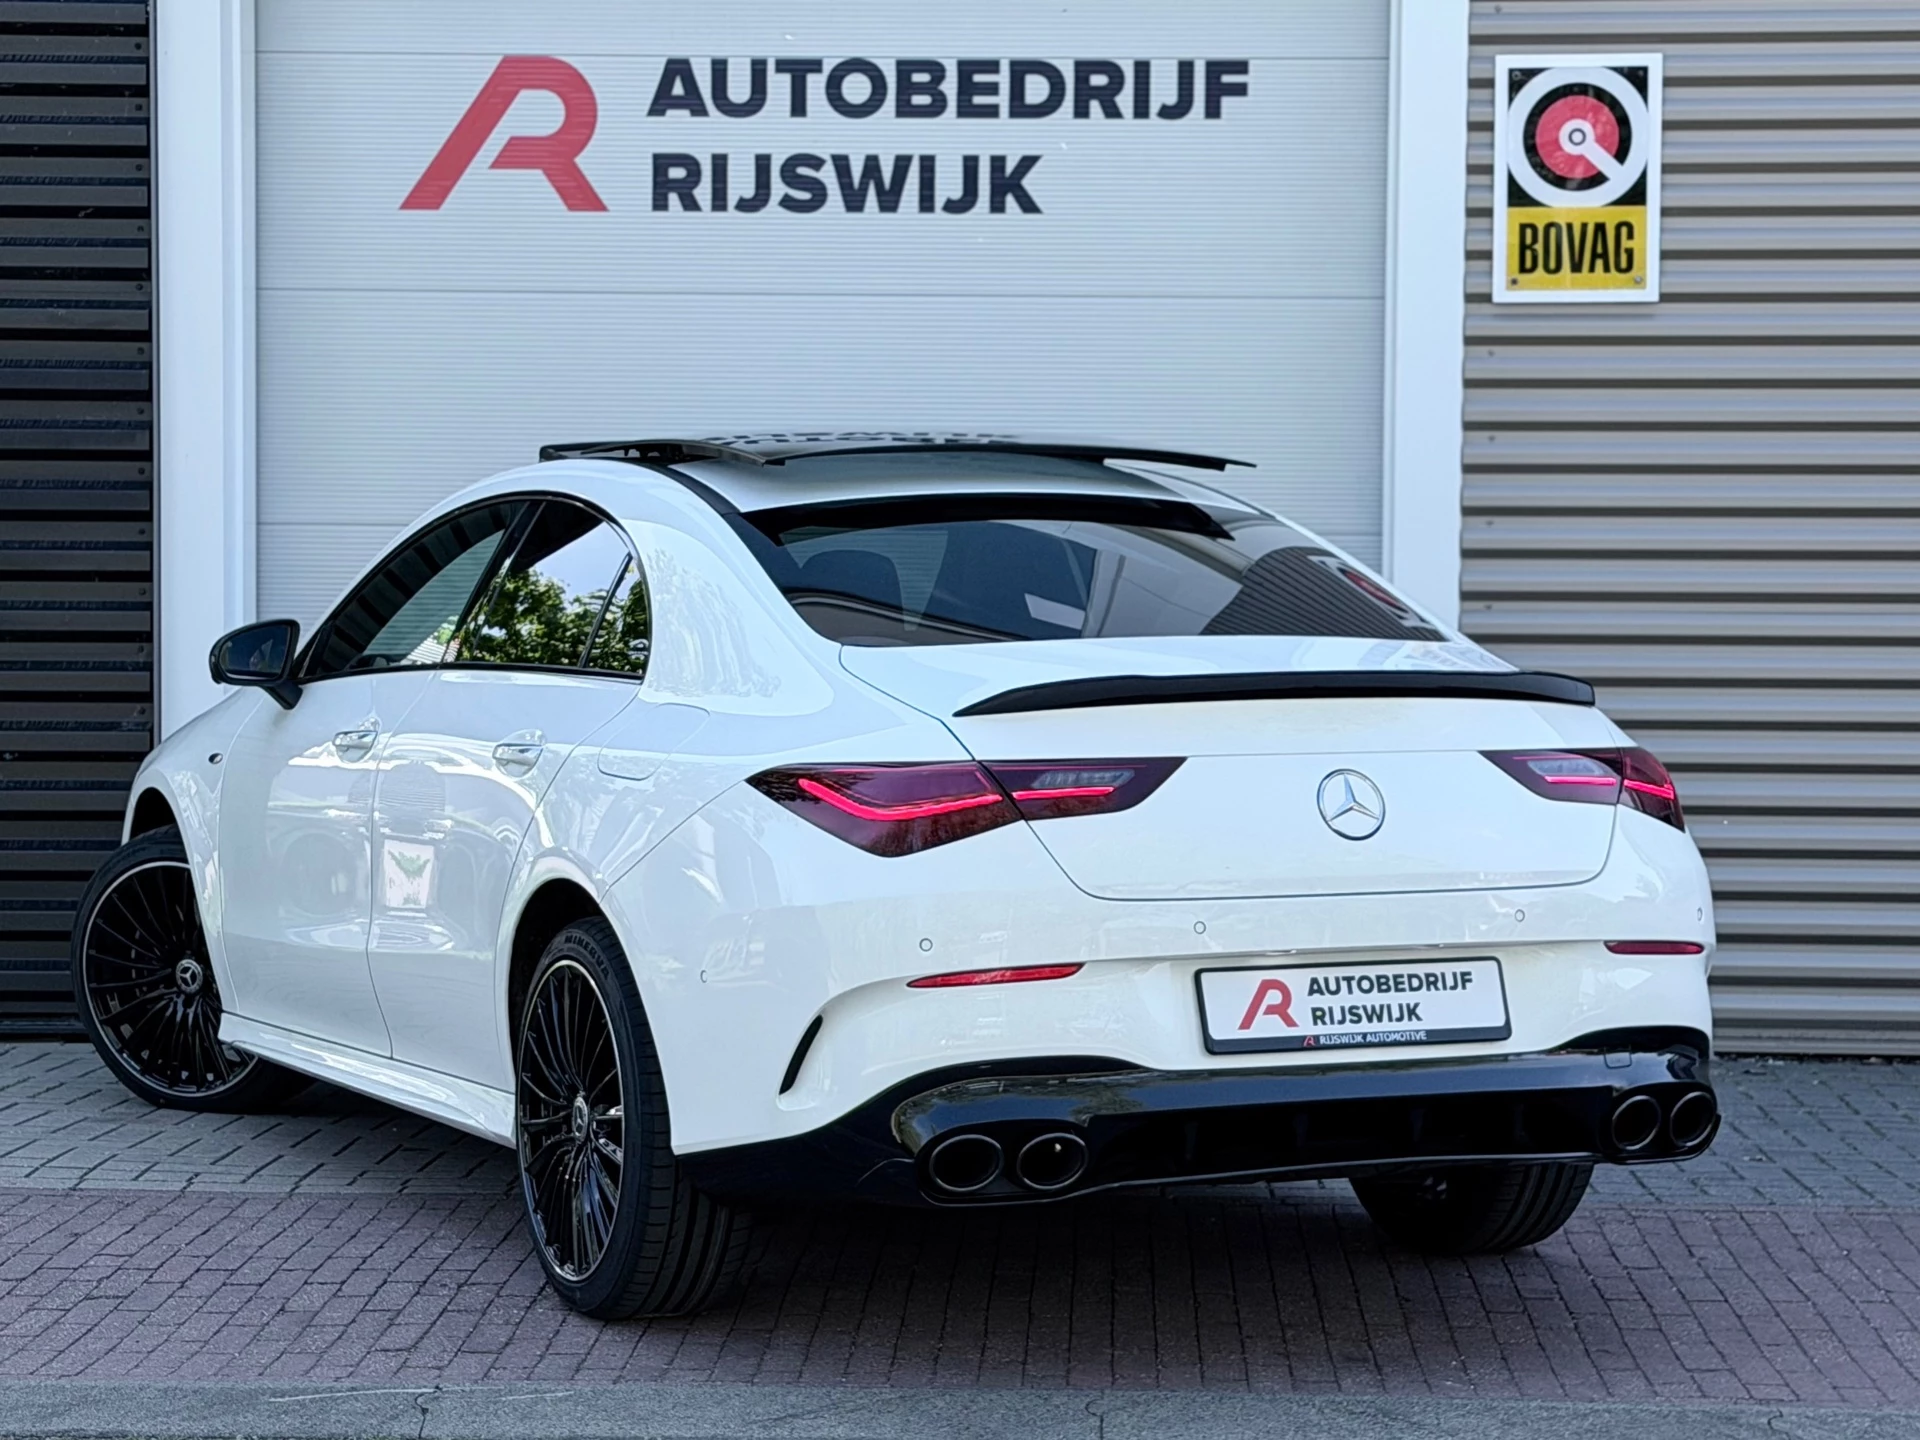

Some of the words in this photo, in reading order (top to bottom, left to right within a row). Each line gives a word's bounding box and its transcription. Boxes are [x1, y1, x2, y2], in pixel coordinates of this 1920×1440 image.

[647, 57, 1249, 121] AUTOBEDRIJF
[651, 153, 1043, 214] RIJSWIJK
[1518, 221, 1634, 275] BOVAG
[1307, 971, 1473, 997] AUTOBEDRIJF
[1310, 1002, 1423, 1026] RIJSWIJK
[1319, 1033, 1364, 1045] RIJSWIJK
[1366, 1030, 1428, 1042] AUTOMOTIVE
